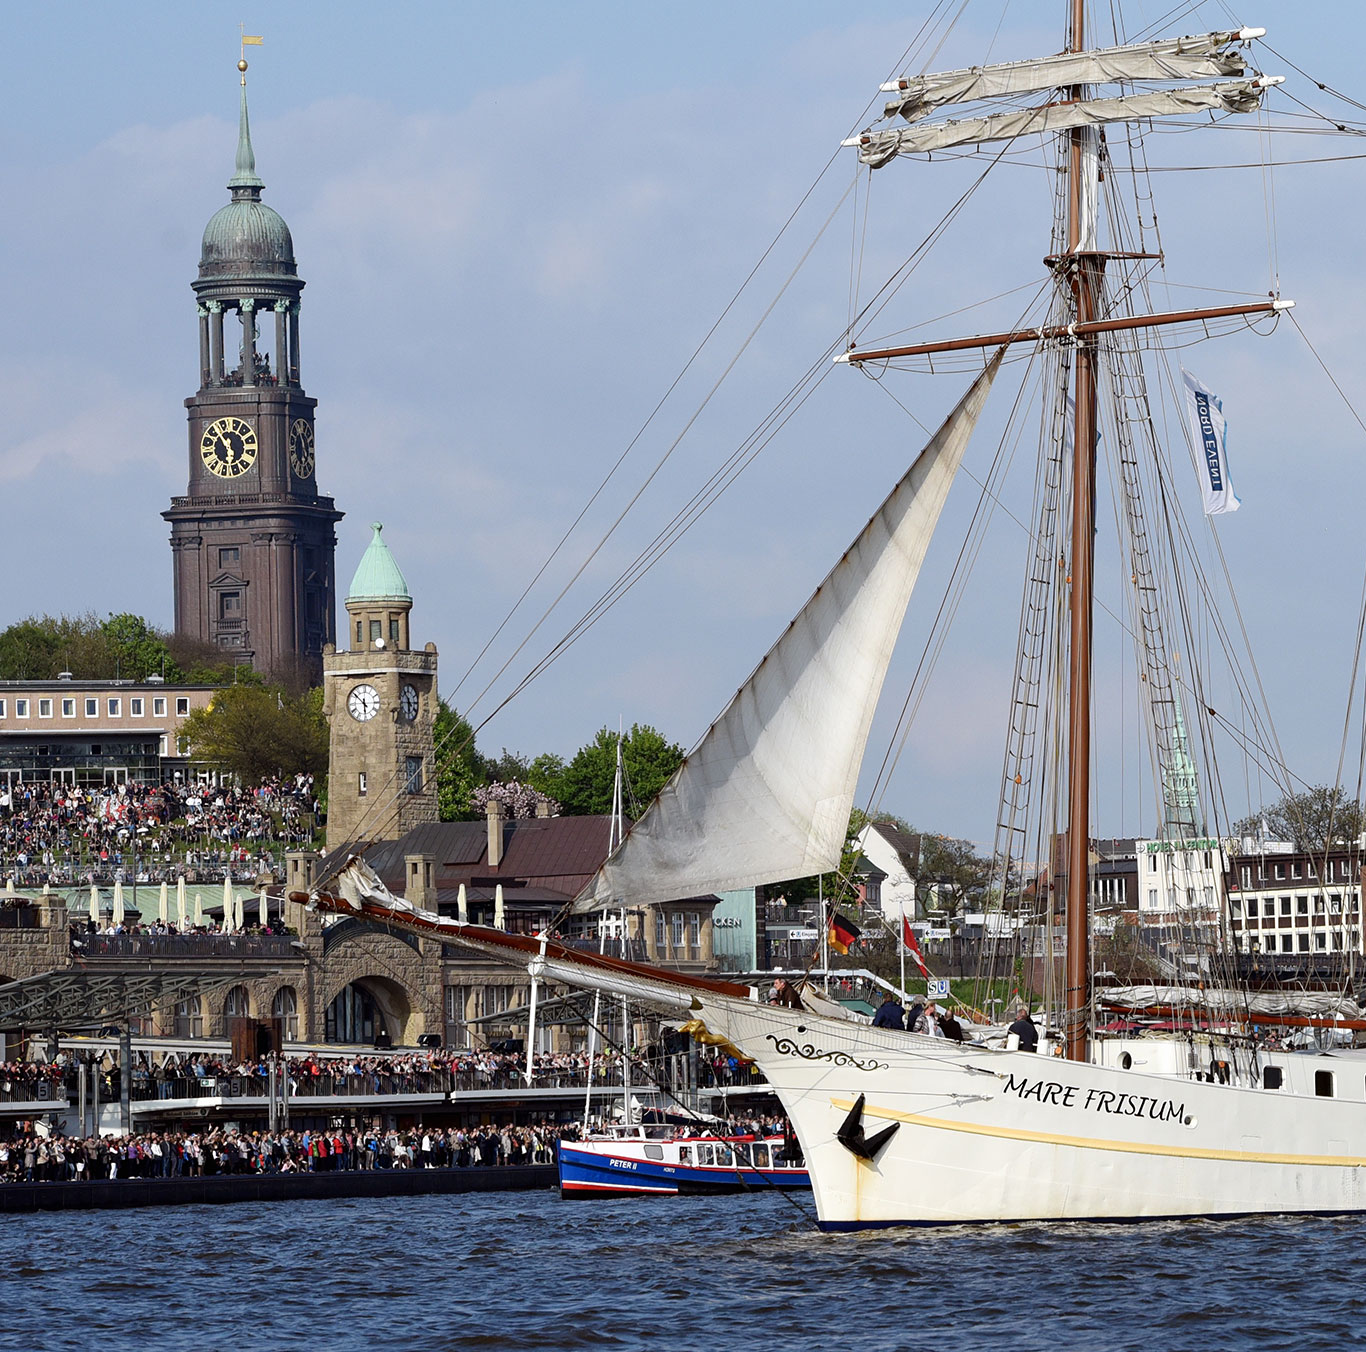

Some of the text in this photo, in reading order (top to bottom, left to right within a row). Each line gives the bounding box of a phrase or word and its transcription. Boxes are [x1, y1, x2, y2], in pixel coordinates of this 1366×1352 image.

[929, 981, 946, 993] S U
[40, 1086, 47, 1097] 5
[1003, 1073, 1185, 1124] MARE FRISIUM
[609, 1159, 632, 1169] PETER
